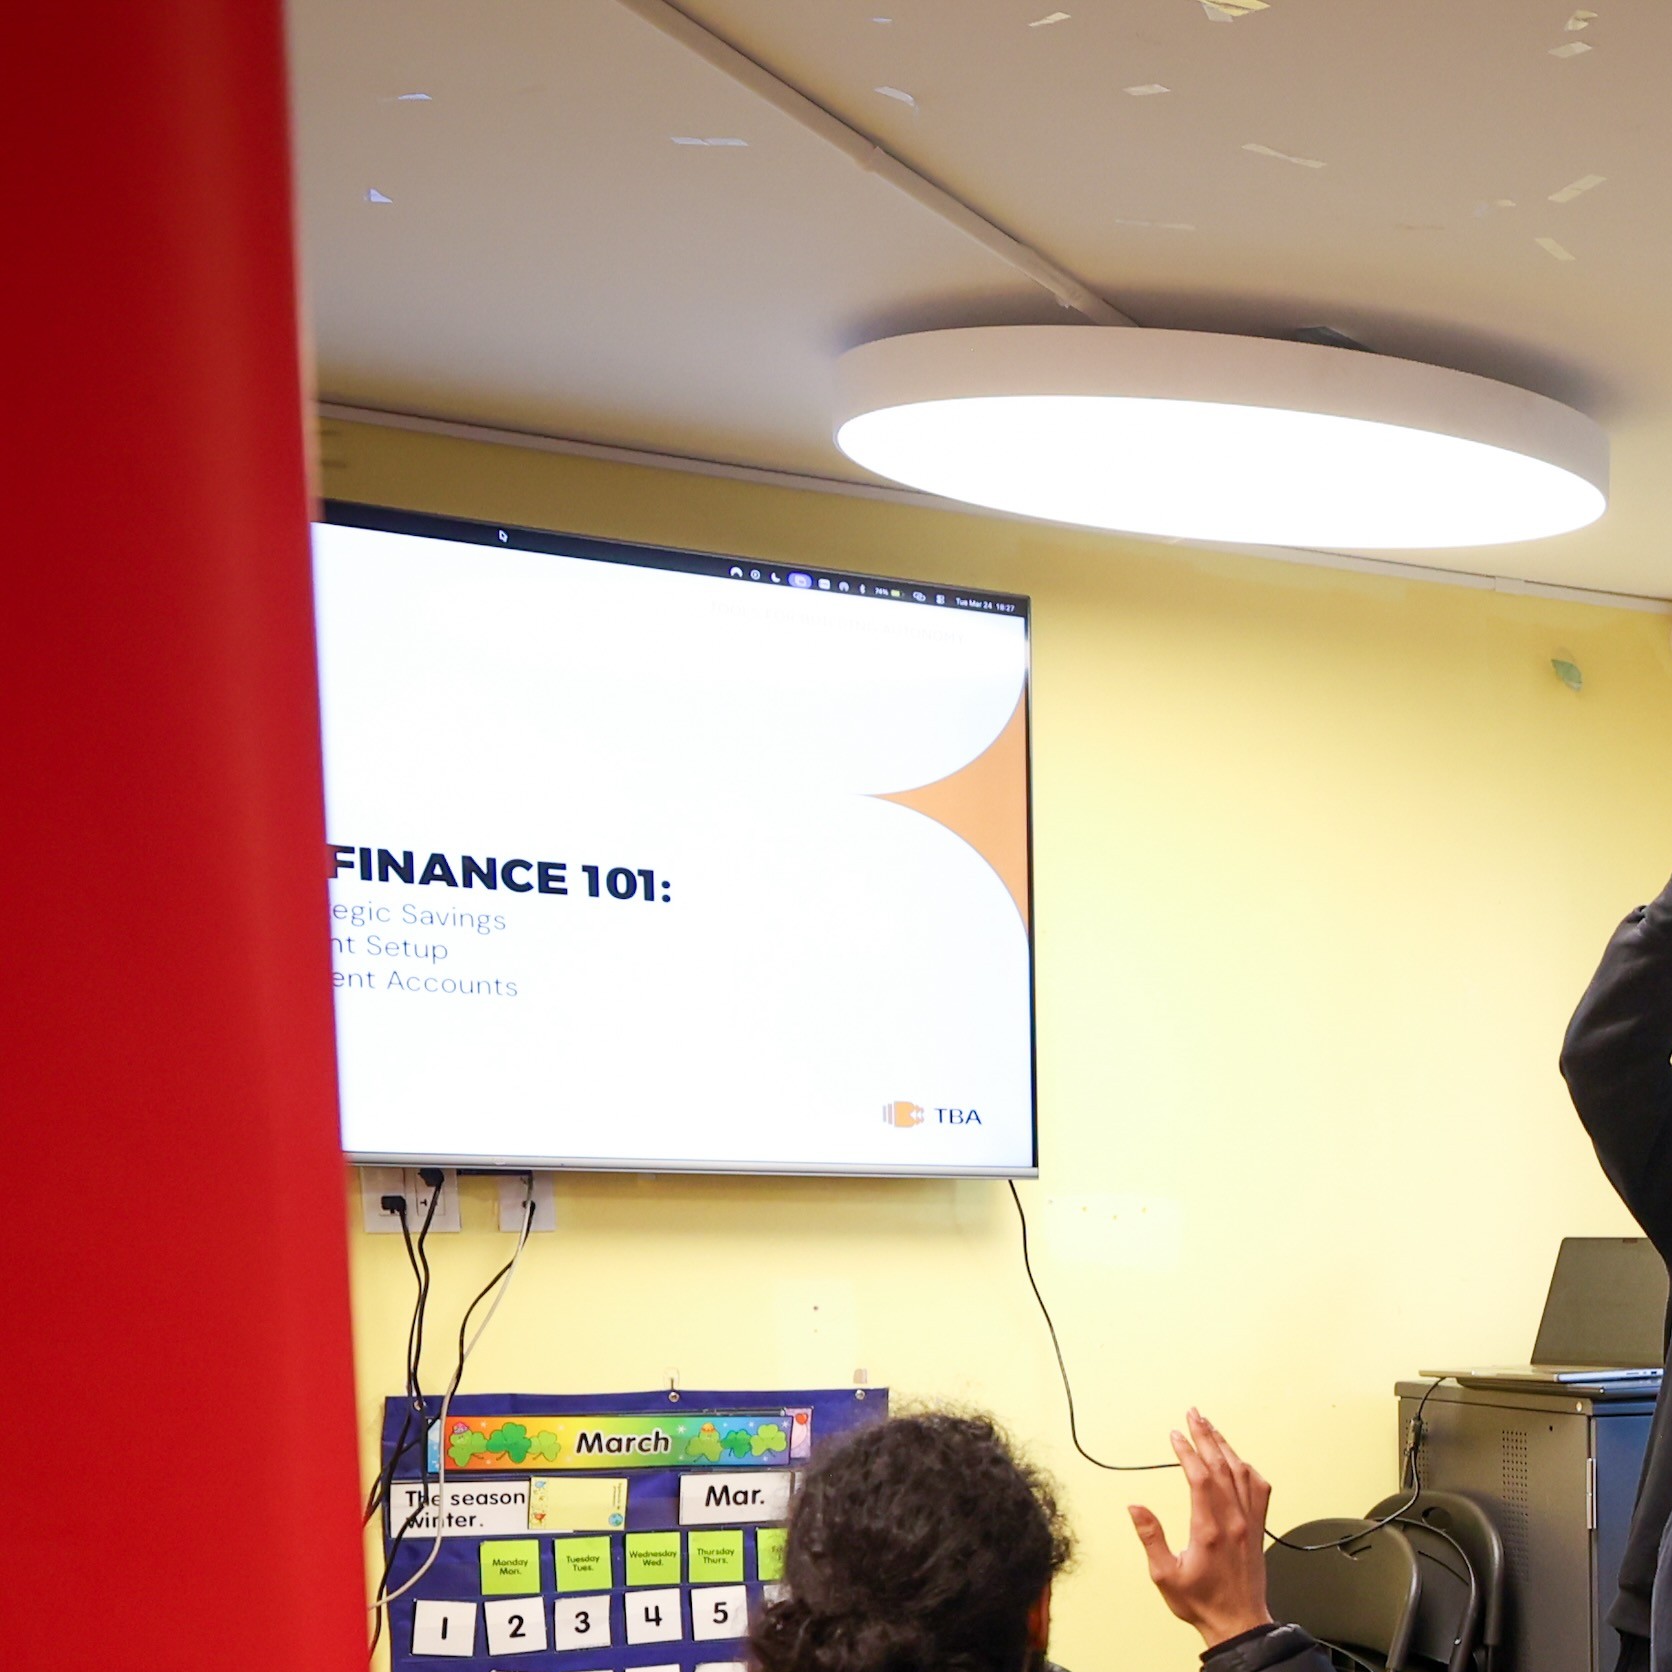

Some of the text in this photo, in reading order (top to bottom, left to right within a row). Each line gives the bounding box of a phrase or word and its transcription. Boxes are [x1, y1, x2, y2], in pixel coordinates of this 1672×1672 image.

[327, 843, 671, 903] FINANCE 101:
[402, 903, 507, 936] Savings
[367, 935, 449, 965] Setup
[387, 970, 519, 998] Accounts
[933, 1108, 983, 1125] TBA
[576, 1429, 671, 1454] March
[405, 1489, 526, 1508] The season
[705, 1485, 765, 1508] Mar.
[566, 1555, 600, 1566] Tuesday
[629, 1549, 677, 1560] Wednesday
[696, 1547, 735, 1558] Thursday
[703, 1556, 728, 1565] Thurs.
[492, 1558, 528, 1569] Monday
[572, 1563, 594, 1572] Tues.
[642, 1558, 664, 1567] Wed.
[499, 1567, 522, 1576] Mon.
[440, 1602, 729, 1640] 1 2 3 4 5
